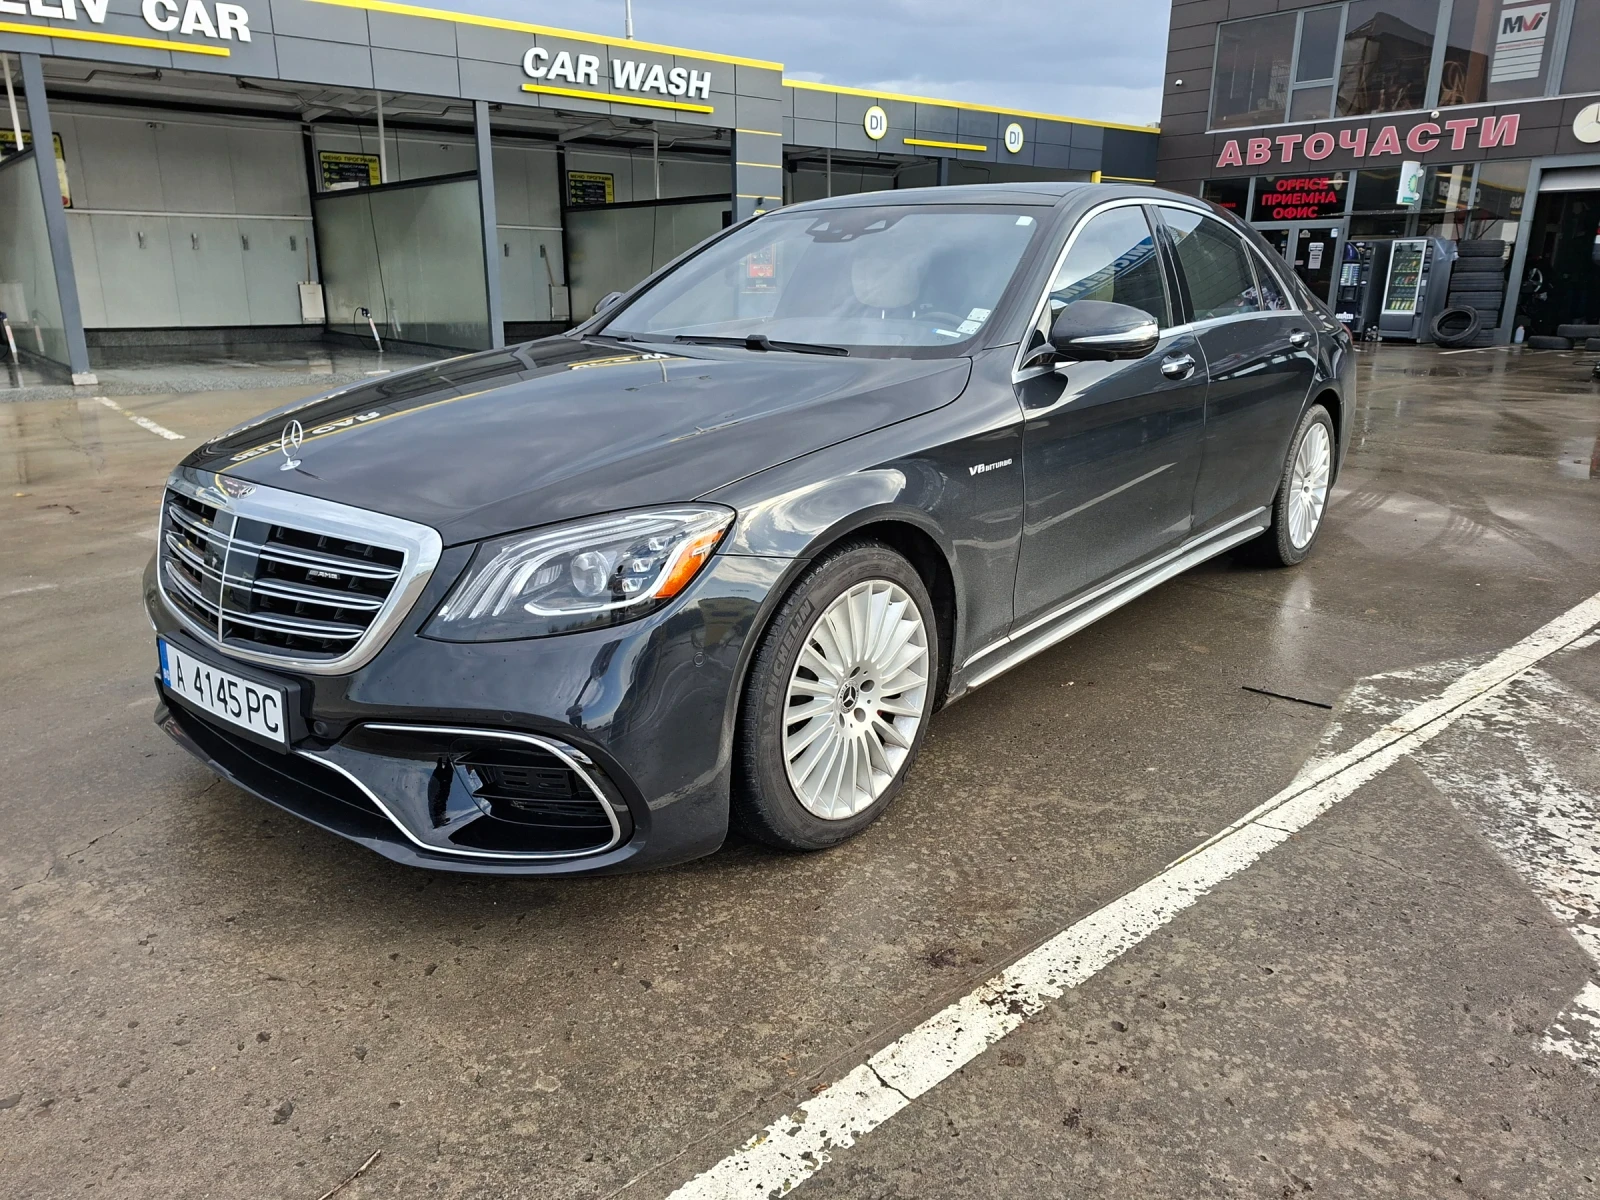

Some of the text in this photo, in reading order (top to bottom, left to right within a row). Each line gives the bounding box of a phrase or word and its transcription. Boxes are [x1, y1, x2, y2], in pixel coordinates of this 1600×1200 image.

[141, 0, 252, 42] CAR
[523, 47, 712, 99] CAR WASH
[870, 114, 883, 131] DI
[1009, 131, 1020, 145] DI
[1216, 113, 1521, 168] АВТОЧАСТИ
[1276, 177, 1329, 191] OFFICE
[1262, 191, 1337, 206] ПРИЕМНА
[1272, 206, 1319, 219] ОФИС
[765, 598, 812, 707] MICHELIN
[176, 655, 186, 692] A
